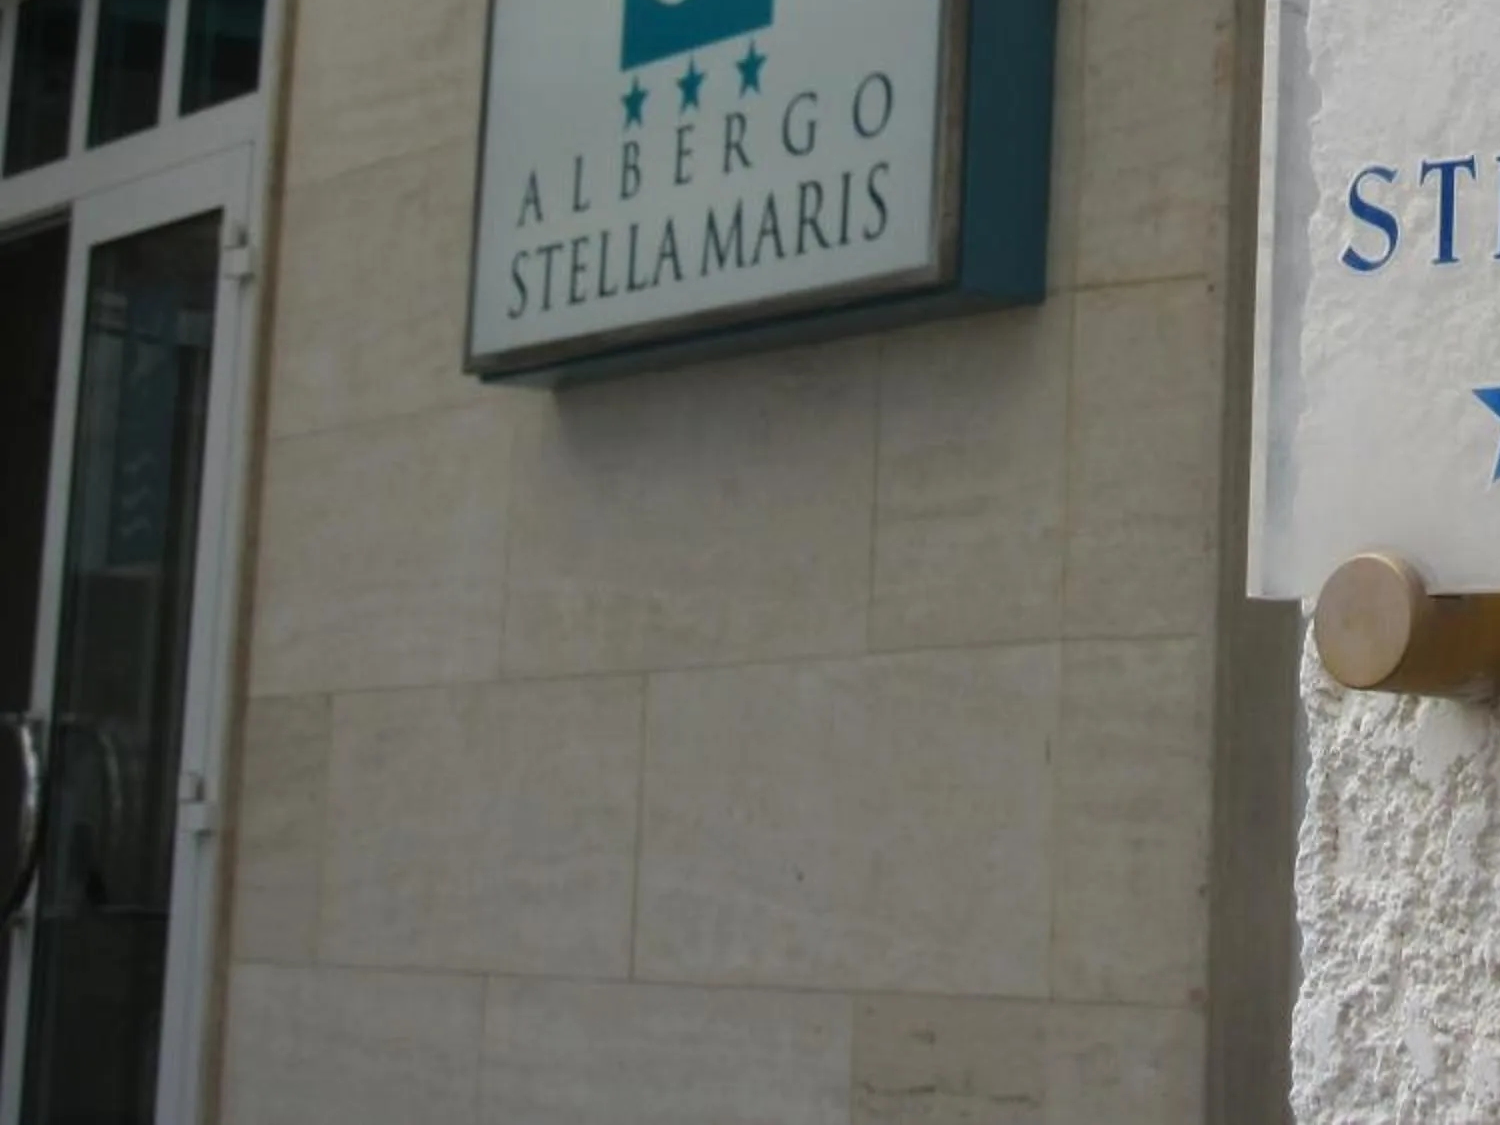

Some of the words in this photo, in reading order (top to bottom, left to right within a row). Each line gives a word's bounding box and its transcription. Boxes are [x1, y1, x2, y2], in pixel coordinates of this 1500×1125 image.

[516, 71, 894, 228] ALBERGO
[507, 217, 684, 320] STELLA
[699, 161, 891, 278] MARIS
